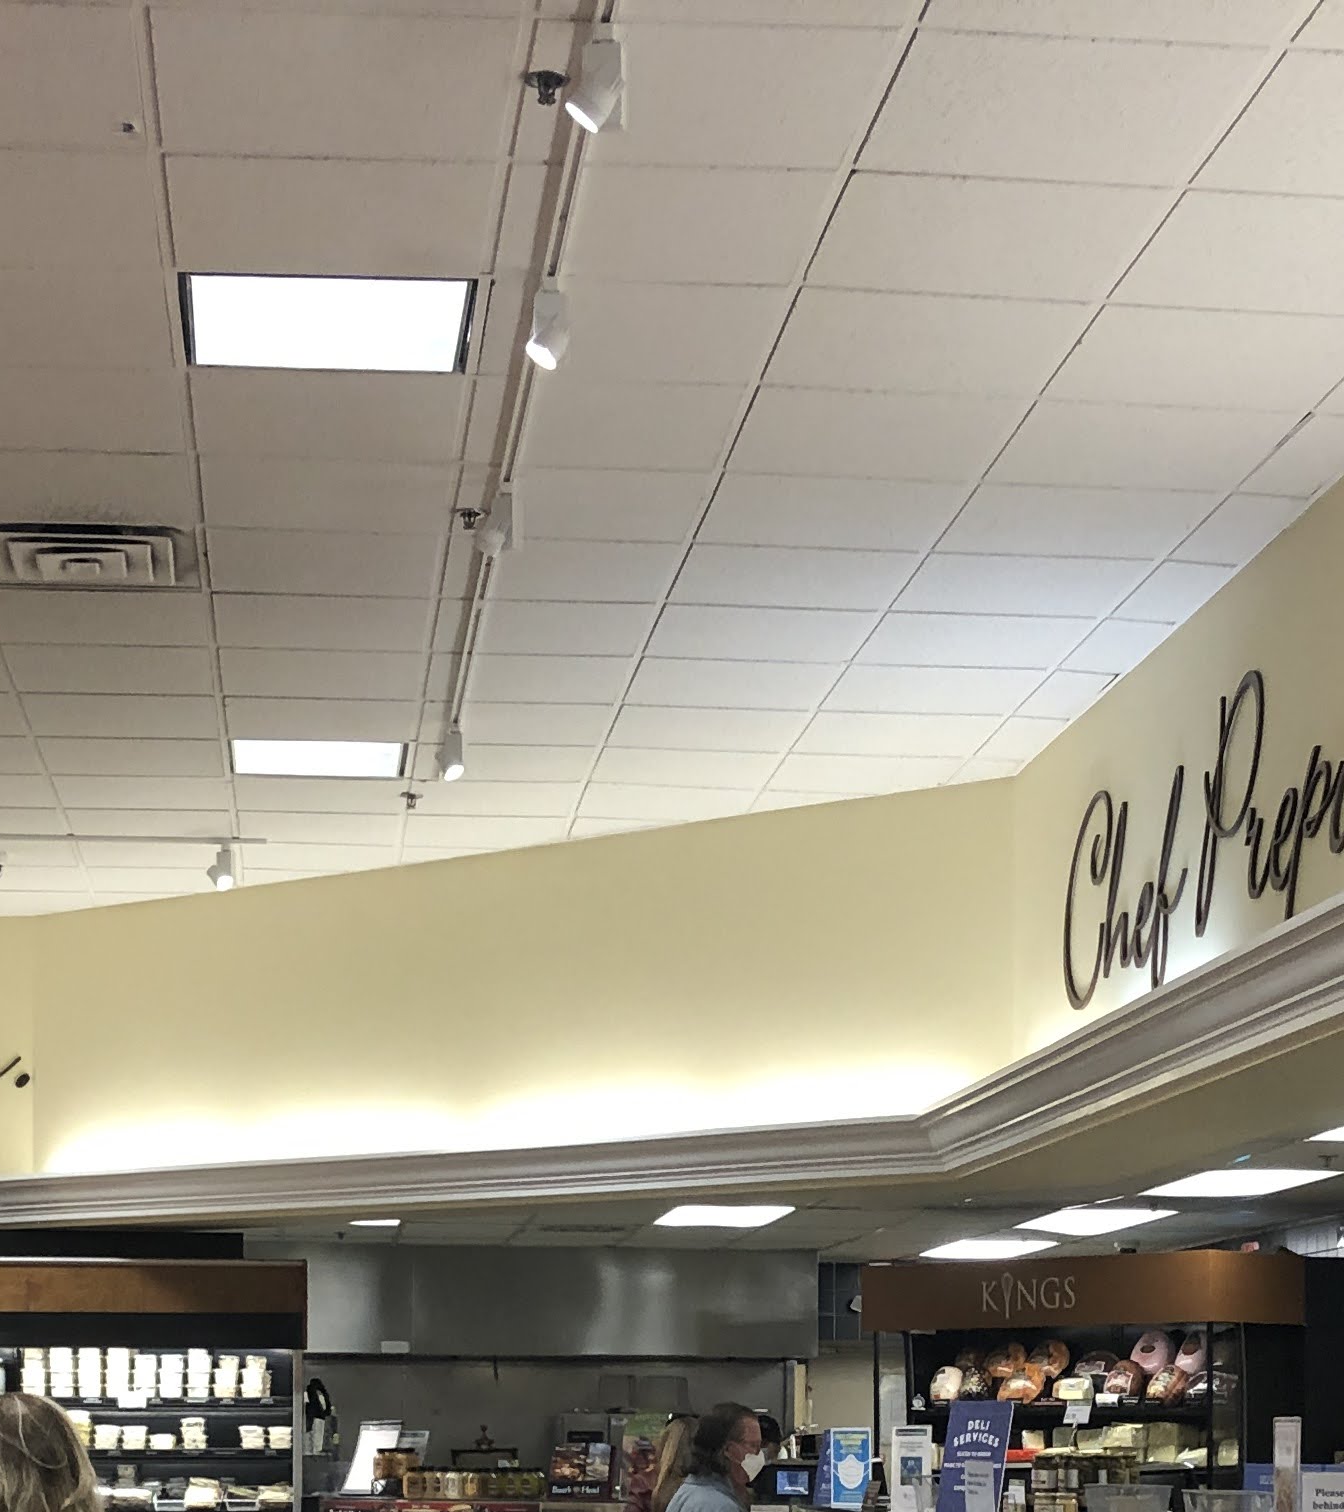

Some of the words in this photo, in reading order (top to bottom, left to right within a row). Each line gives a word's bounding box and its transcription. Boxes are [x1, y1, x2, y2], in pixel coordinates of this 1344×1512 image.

[1064, 766, 1188, 1011] Chef
[981, 1271, 1076, 1319] KINGS
[967, 1420, 991, 1431] DELI
[953, 1432, 1000, 1448] SERVICES
[1312, 1501, 1344, 1510] behind
